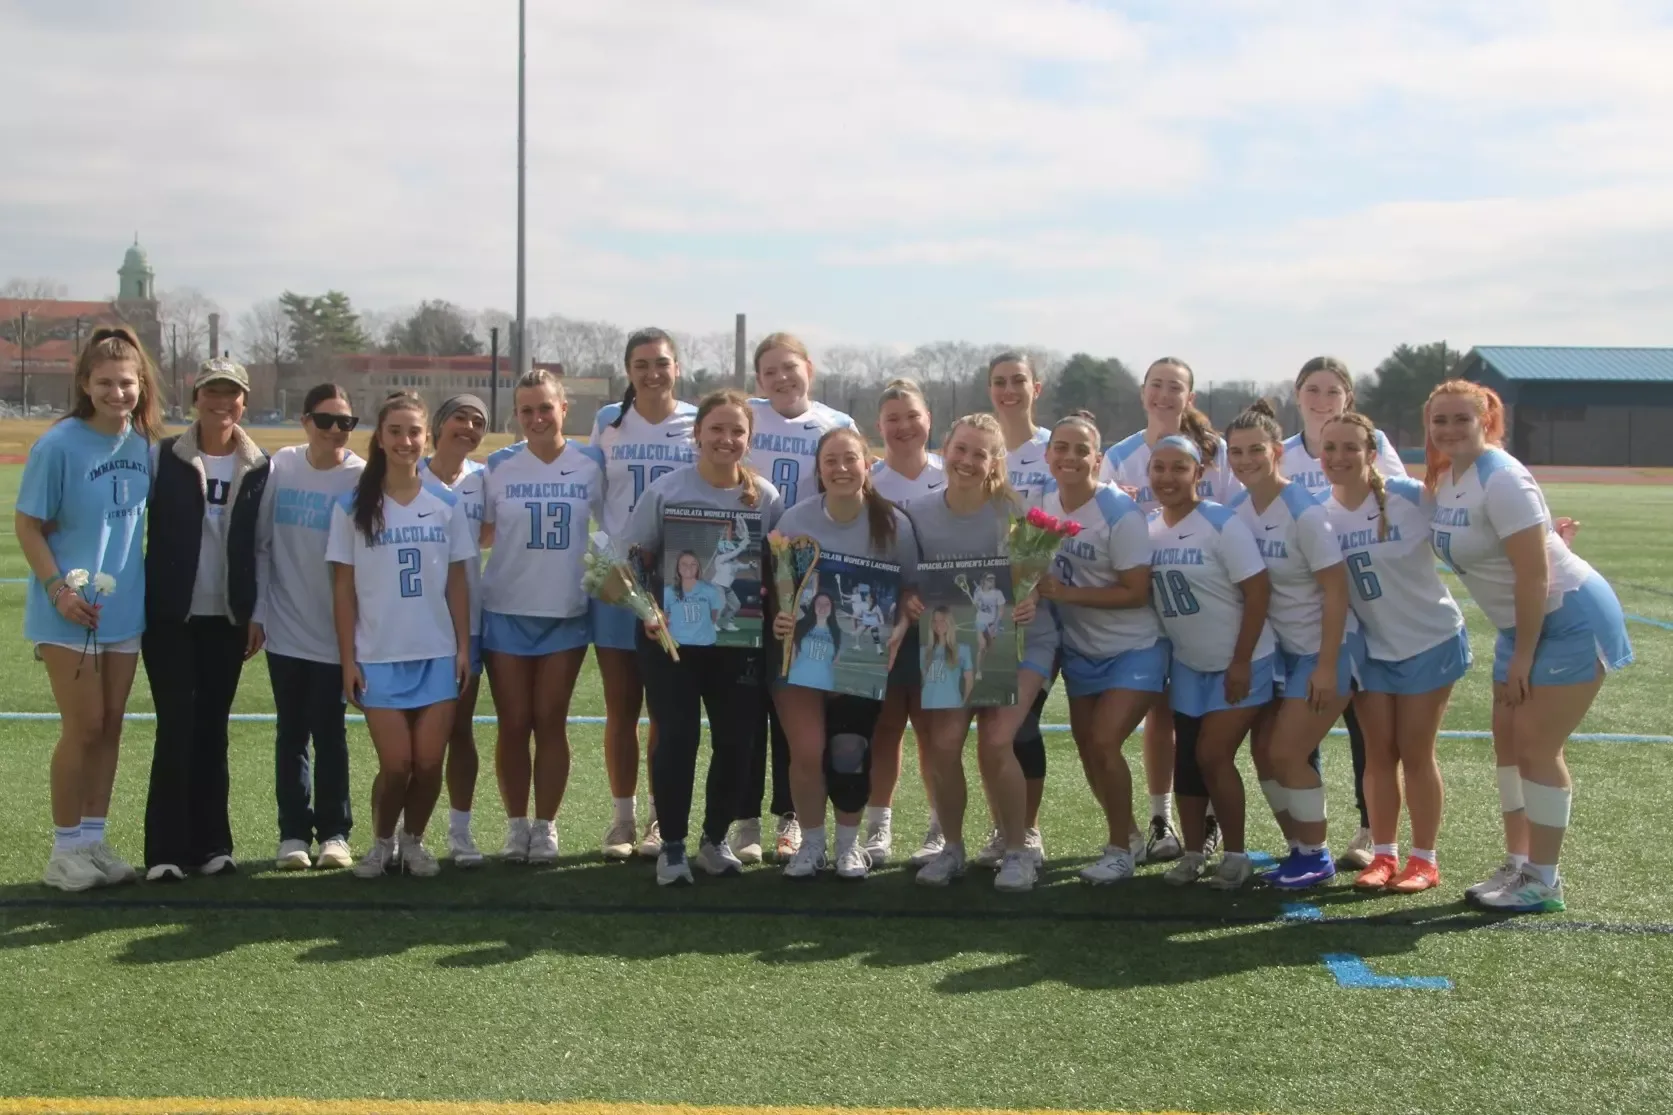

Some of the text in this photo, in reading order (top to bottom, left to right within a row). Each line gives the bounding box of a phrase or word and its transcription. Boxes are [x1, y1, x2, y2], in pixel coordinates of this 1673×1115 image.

[525, 502, 571, 550] 13
[665, 507, 762, 520] IMMACULATA WOMEN'S LACROSSE
[398, 548, 422, 597] 2
[843, 555, 870, 567] WOMEN'S
[870, 561, 901, 573] LACROSSE
[917, 561, 954, 571] IMMACULATA
[955, 559, 982, 568] WOMEN'S
[1346, 551, 1382, 601] 6
[1151, 570, 1200, 617] 18
